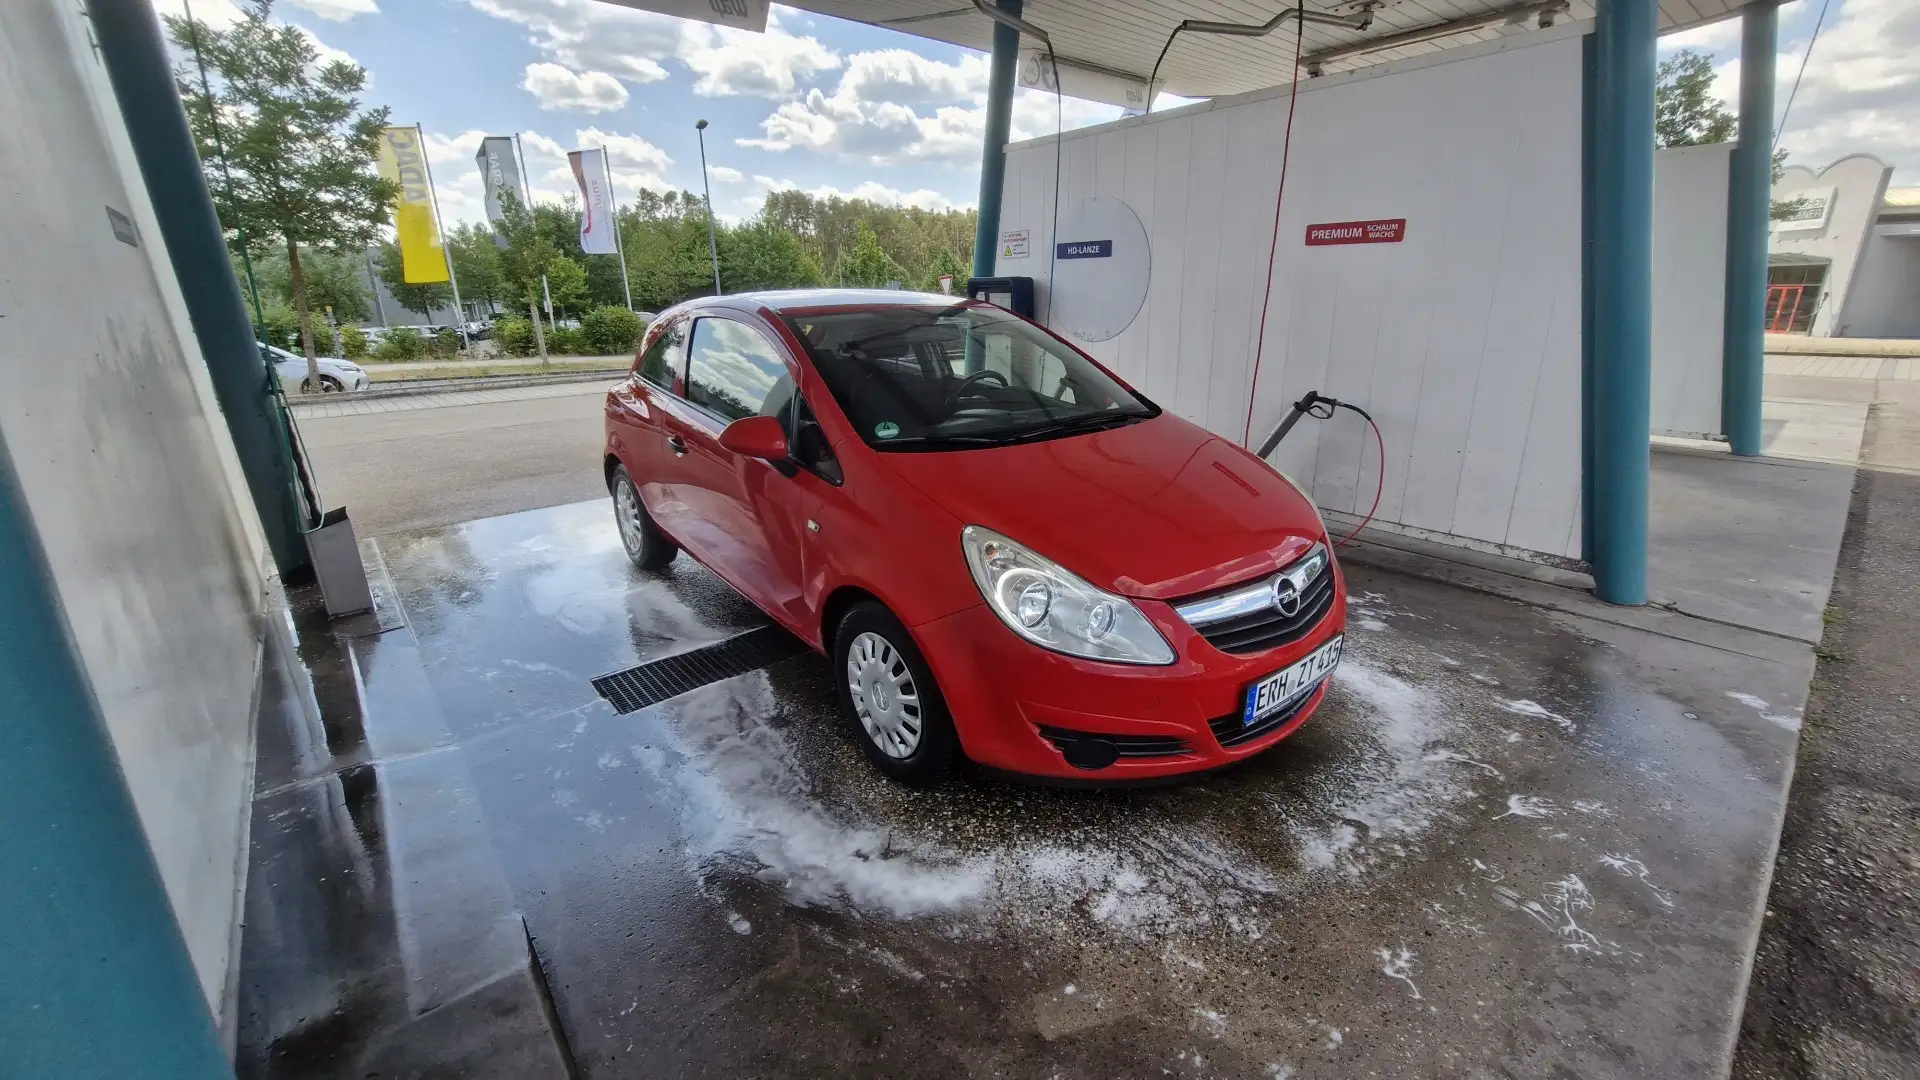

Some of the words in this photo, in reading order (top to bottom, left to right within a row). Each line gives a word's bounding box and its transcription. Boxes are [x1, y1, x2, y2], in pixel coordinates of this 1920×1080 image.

[1367, 223, 1399, 232] SCHAUM
[1312, 227, 1363, 240] PREMIUM
[1368, 231, 1395, 239] WACHS
[1067, 245, 1100, 255] HD-LANZE
[883, 422, 890, 430] 4
[1256, 672, 1289, 712] ERH
[1297, 656, 1317, 688] ZT
[1317, 640, 1341, 672] 415
